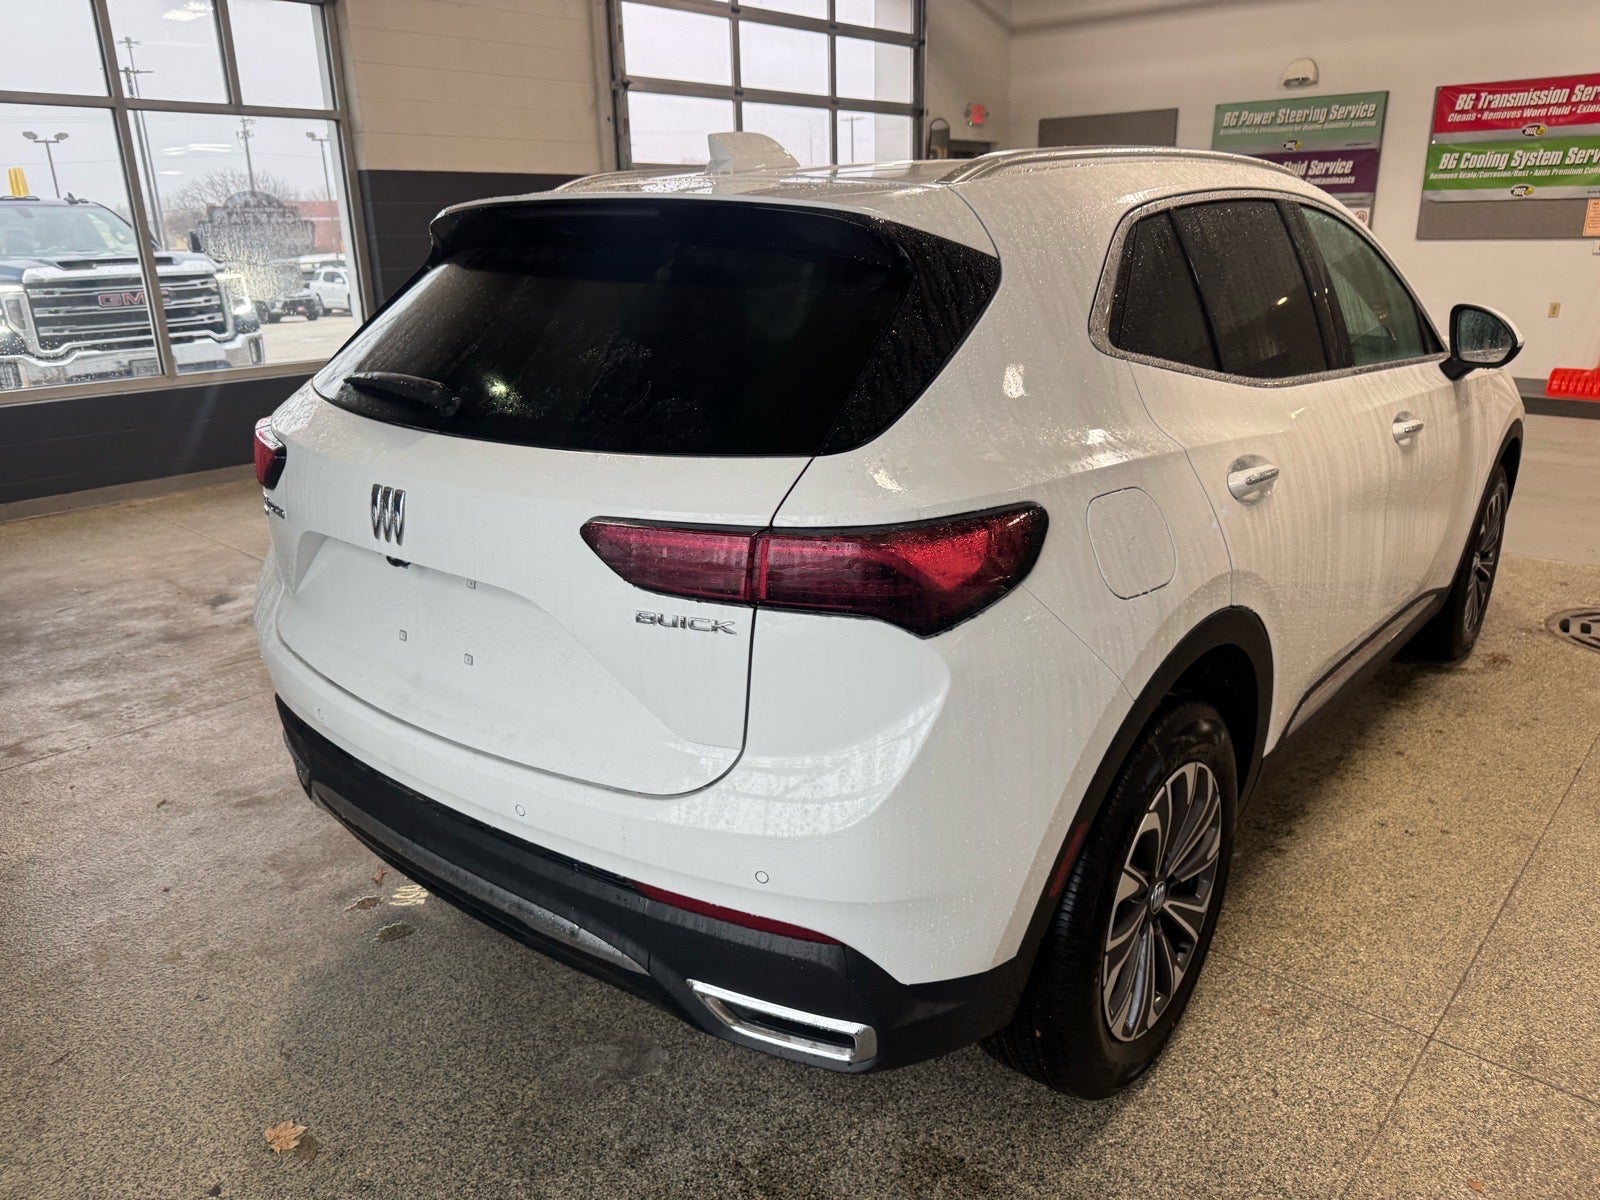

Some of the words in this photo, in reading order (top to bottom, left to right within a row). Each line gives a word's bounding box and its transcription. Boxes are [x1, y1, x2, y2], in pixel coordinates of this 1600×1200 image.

[1456, 93, 1476, 111] BG
[1478, 87, 1570, 109] Transmission
[1222, 111, 1239, 127] BG
[1239, 110, 1276, 126] Power
[1277, 106, 1328, 124] Steering
[1328, 101, 1377, 119] Service
[1447, 113, 1477, 123] Cleans
[1481, 111, 1523, 120] Removes
[1522, 108, 1548, 118] Worn
[1547, 105, 1572, 116] Fluid
[1307, 158, 1354, 176] Service
[1439, 153, 1459, 170] BG
[1460, 151, 1510, 171] Cooling
[1511, 148, 1563, 170] System
[636, 610, 737, 635] BUICK
